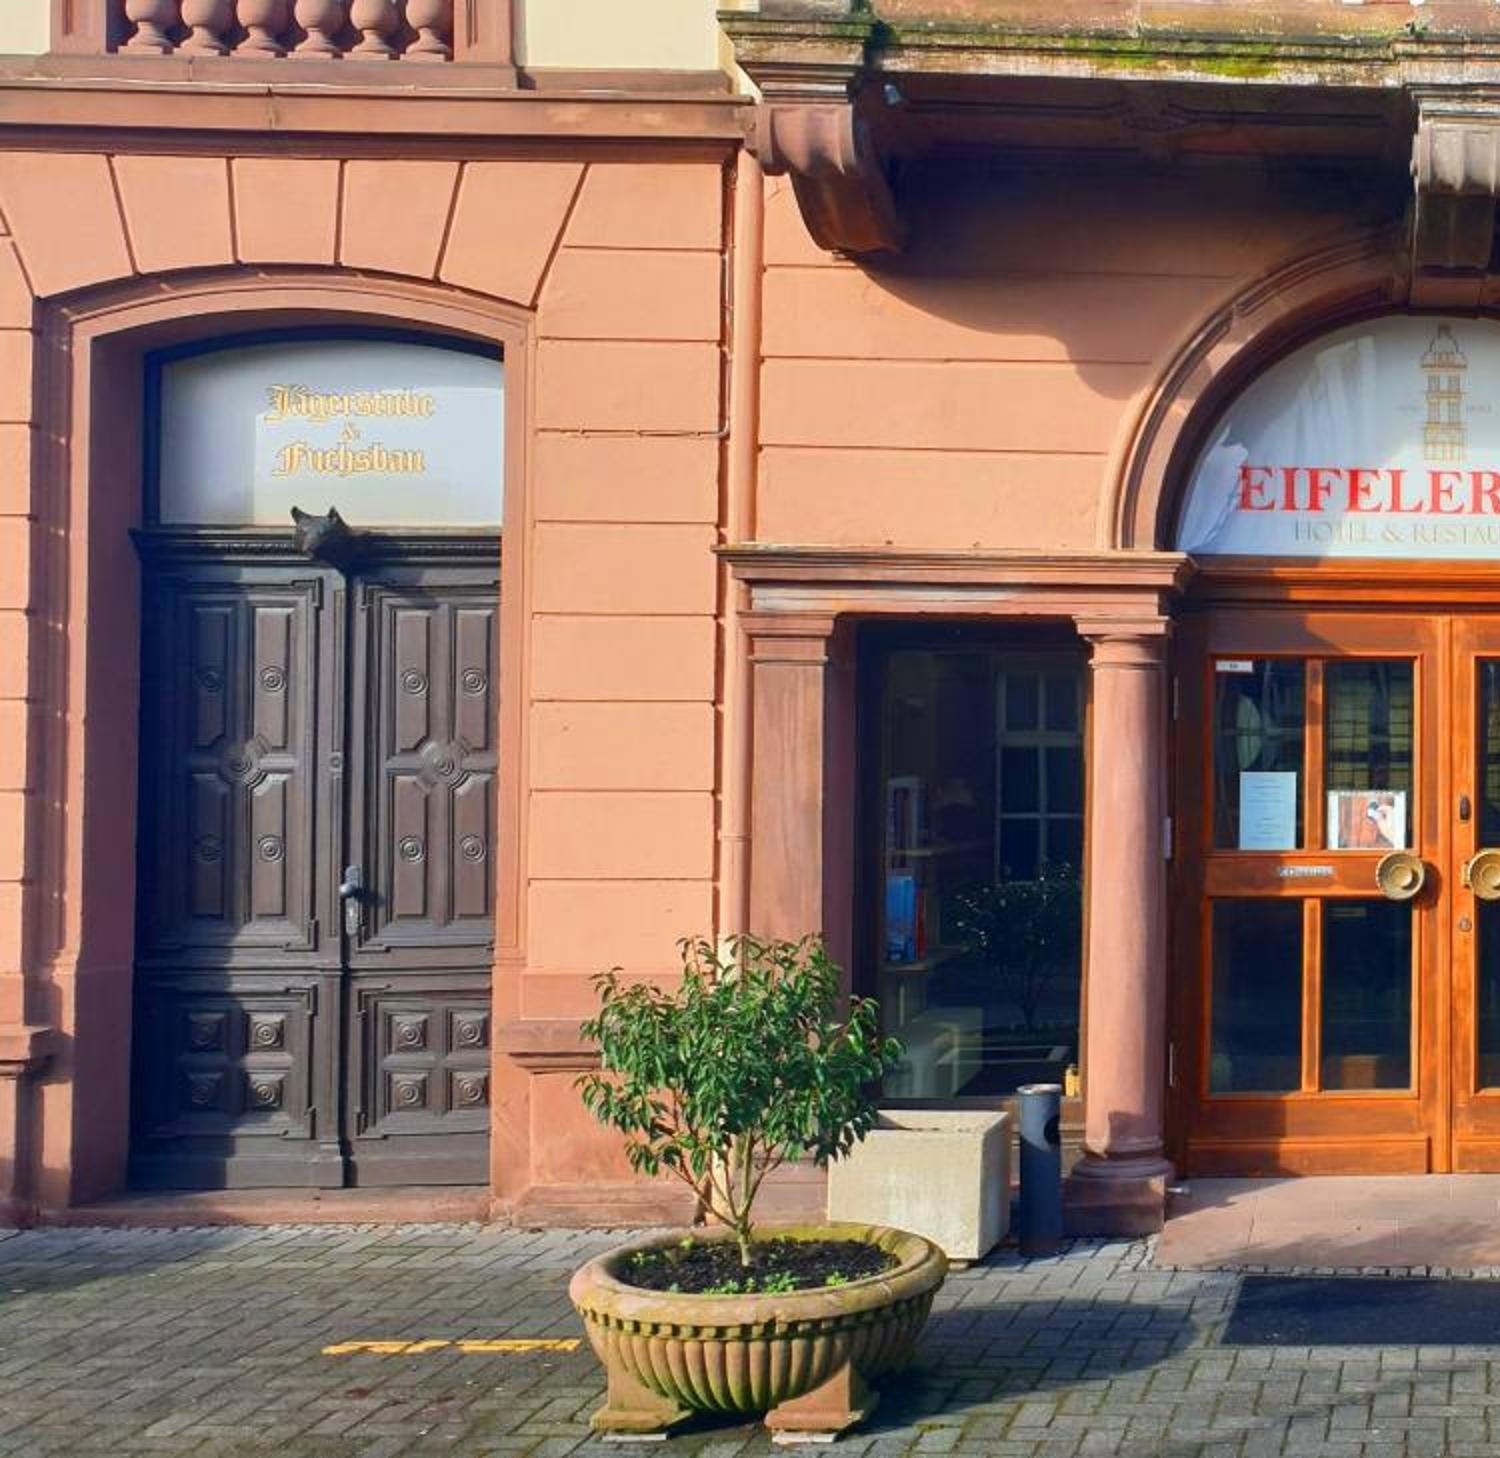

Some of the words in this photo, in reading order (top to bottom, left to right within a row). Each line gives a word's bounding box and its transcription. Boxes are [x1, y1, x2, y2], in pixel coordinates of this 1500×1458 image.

[264, 384, 434, 422] Jägerstube
[341, 422, 361, 441] &
[272, 442, 426, 477] Fuchsbau
[1294, 519, 1376, 544] HOTEL
[1384, 523, 1405, 544] &
